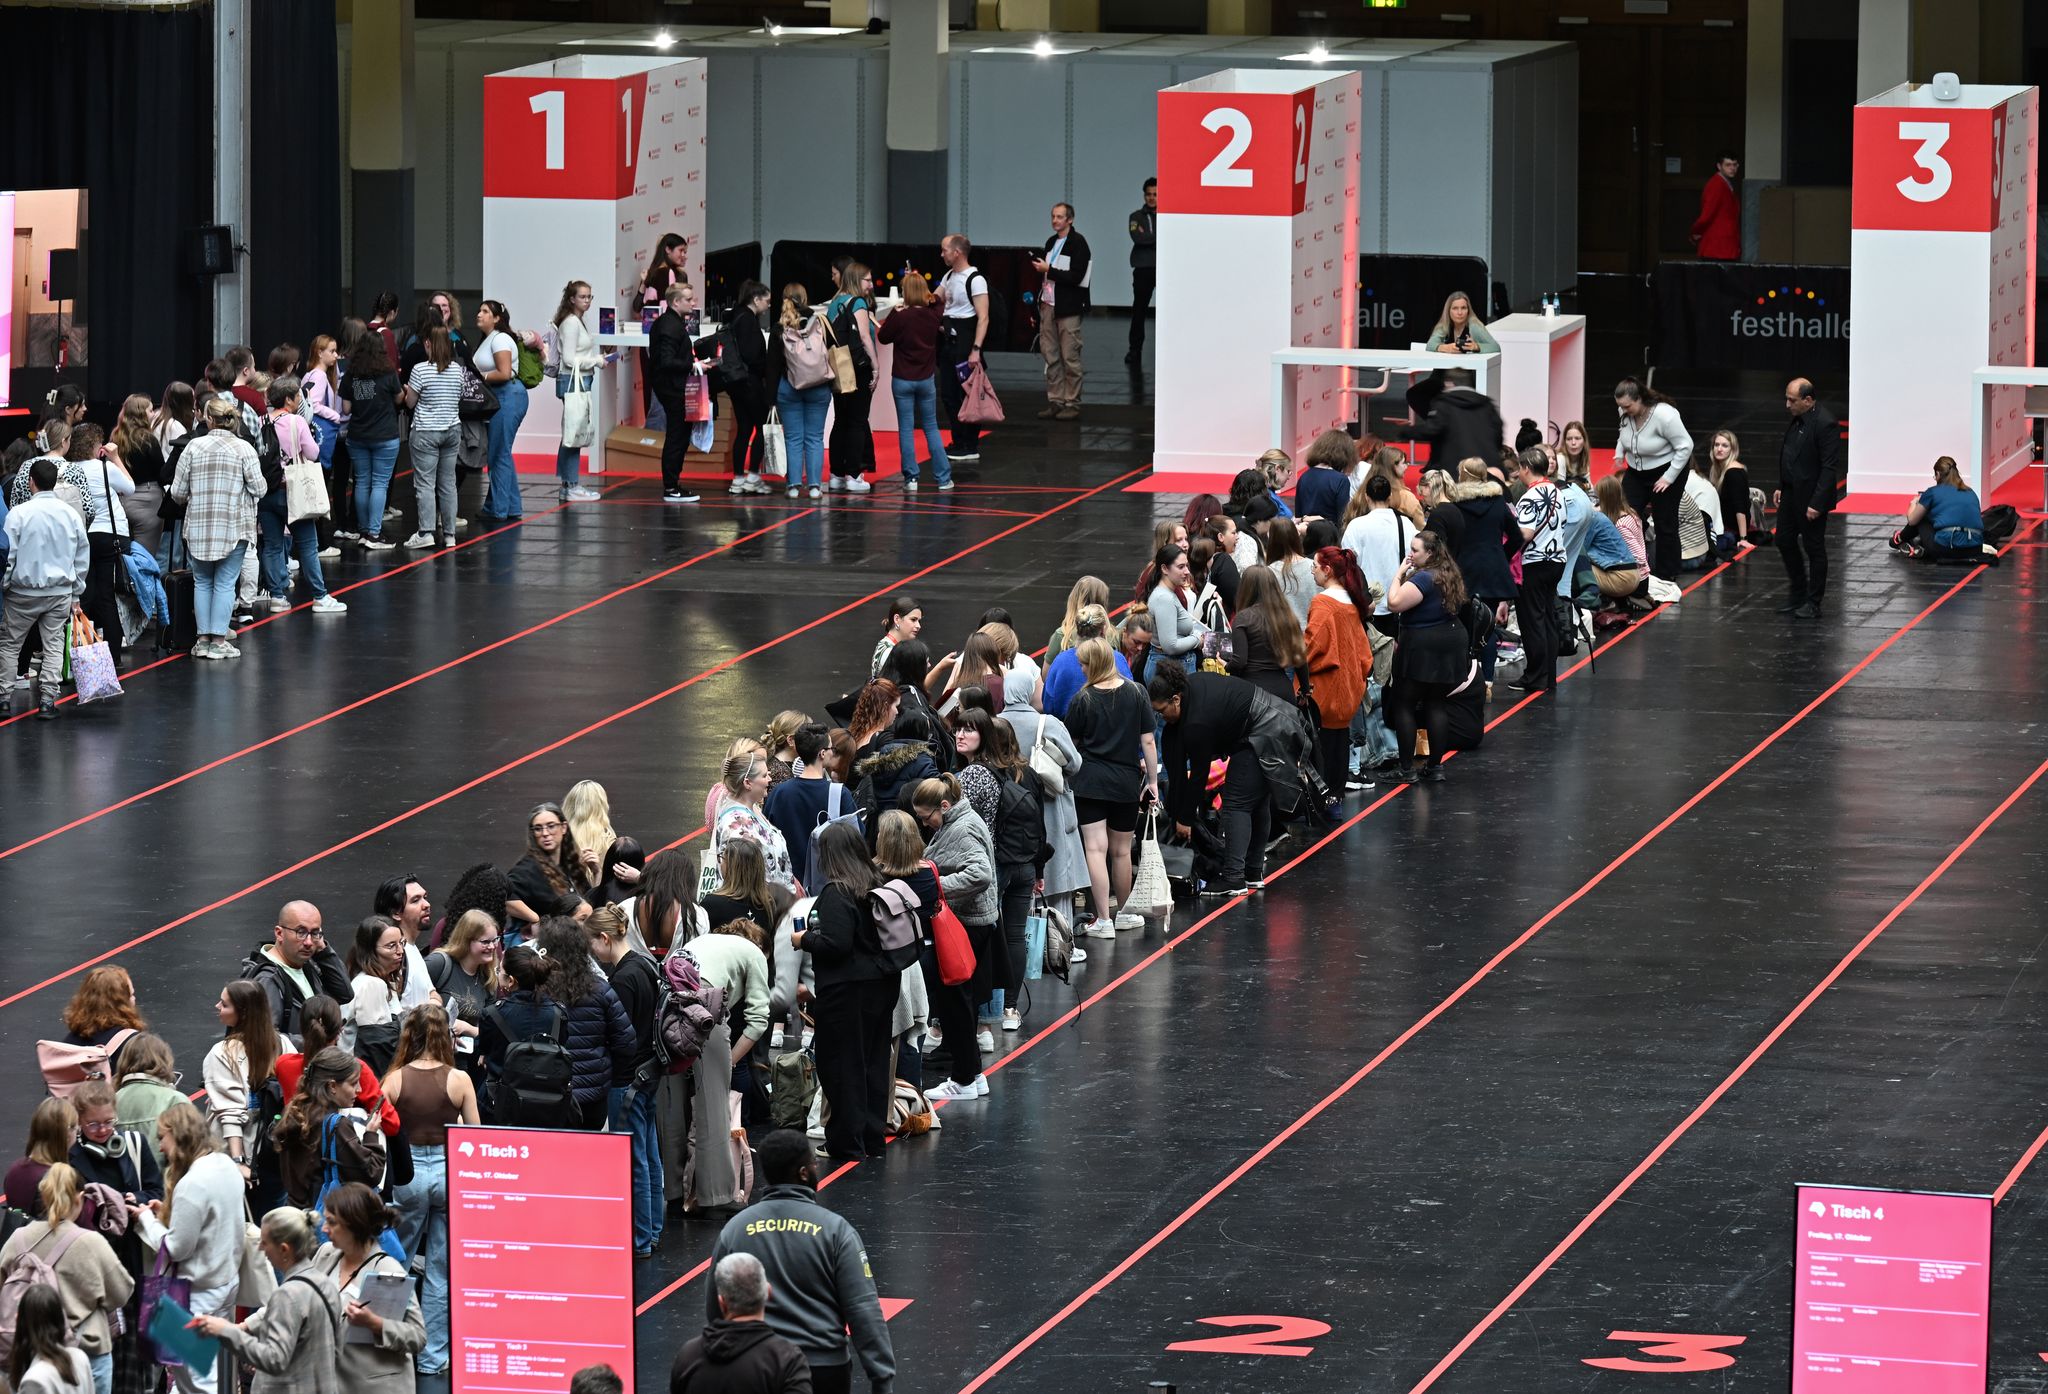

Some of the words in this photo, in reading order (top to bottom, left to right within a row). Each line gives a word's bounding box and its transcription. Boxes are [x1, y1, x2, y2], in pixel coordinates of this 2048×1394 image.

[529, 90, 565, 170] 1
[621, 88, 633, 168] 1
[1201, 107, 1253, 188] 2
[1295, 103, 1306, 185] 2
[1896, 121, 1953, 203] 3
[1993, 118, 2001, 200] 3
[479, 1143, 517, 1158] Tisch
[520, 1146, 530, 1159] 3
[745, 1218, 823, 1237] SECURITY
[1831, 1203, 1871, 1220] Tisch
[1874, 1207, 1885, 1221] 4
[1165, 1315, 1332, 1357] 2
[1581, 1330, 1748, 1373] 3
